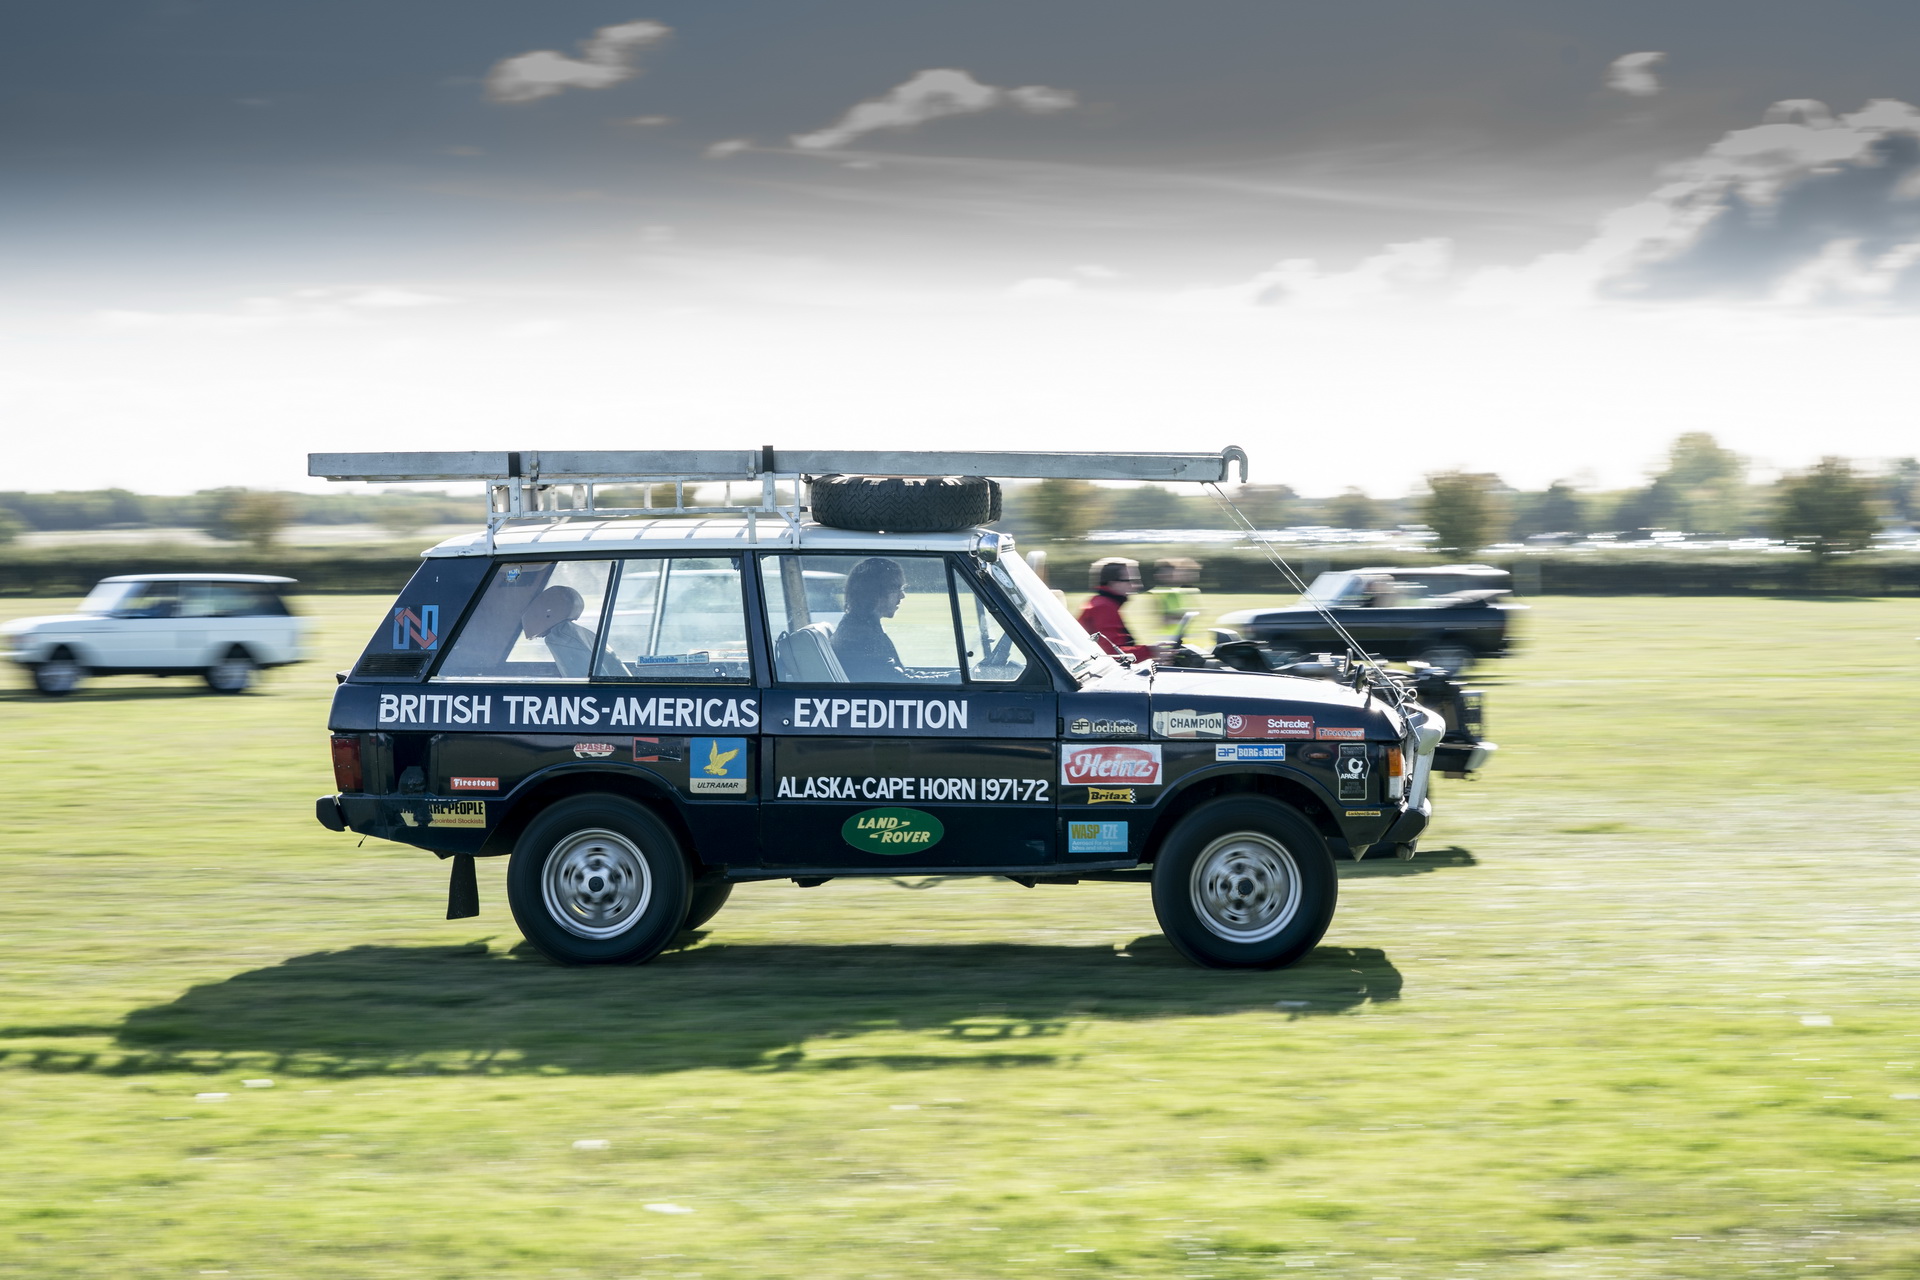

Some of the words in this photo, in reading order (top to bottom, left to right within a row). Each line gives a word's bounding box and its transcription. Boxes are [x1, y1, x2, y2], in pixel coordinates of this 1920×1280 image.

[380, 693, 491, 724] BRITISH
[503, 695, 759, 728] TRANS-AMERICAS
[794, 698, 968, 729] EXPEDITION
[1170, 718, 1222, 729] CHAMPION
[1267, 718, 1310, 729] Schrader
[1069, 753, 1154, 778] Heinz
[453, 778, 496, 787] Firestone
[777, 776, 915, 799] ALASKA-CAPE
[920, 778, 976, 800] HORN
[981, 779, 1049, 801] 1971-72
[1091, 791, 1128, 800] Britax
[448, 802, 484, 815] PEOPLE
[857, 817, 898, 829] LAND
[882, 831, 930, 843] ROVER
